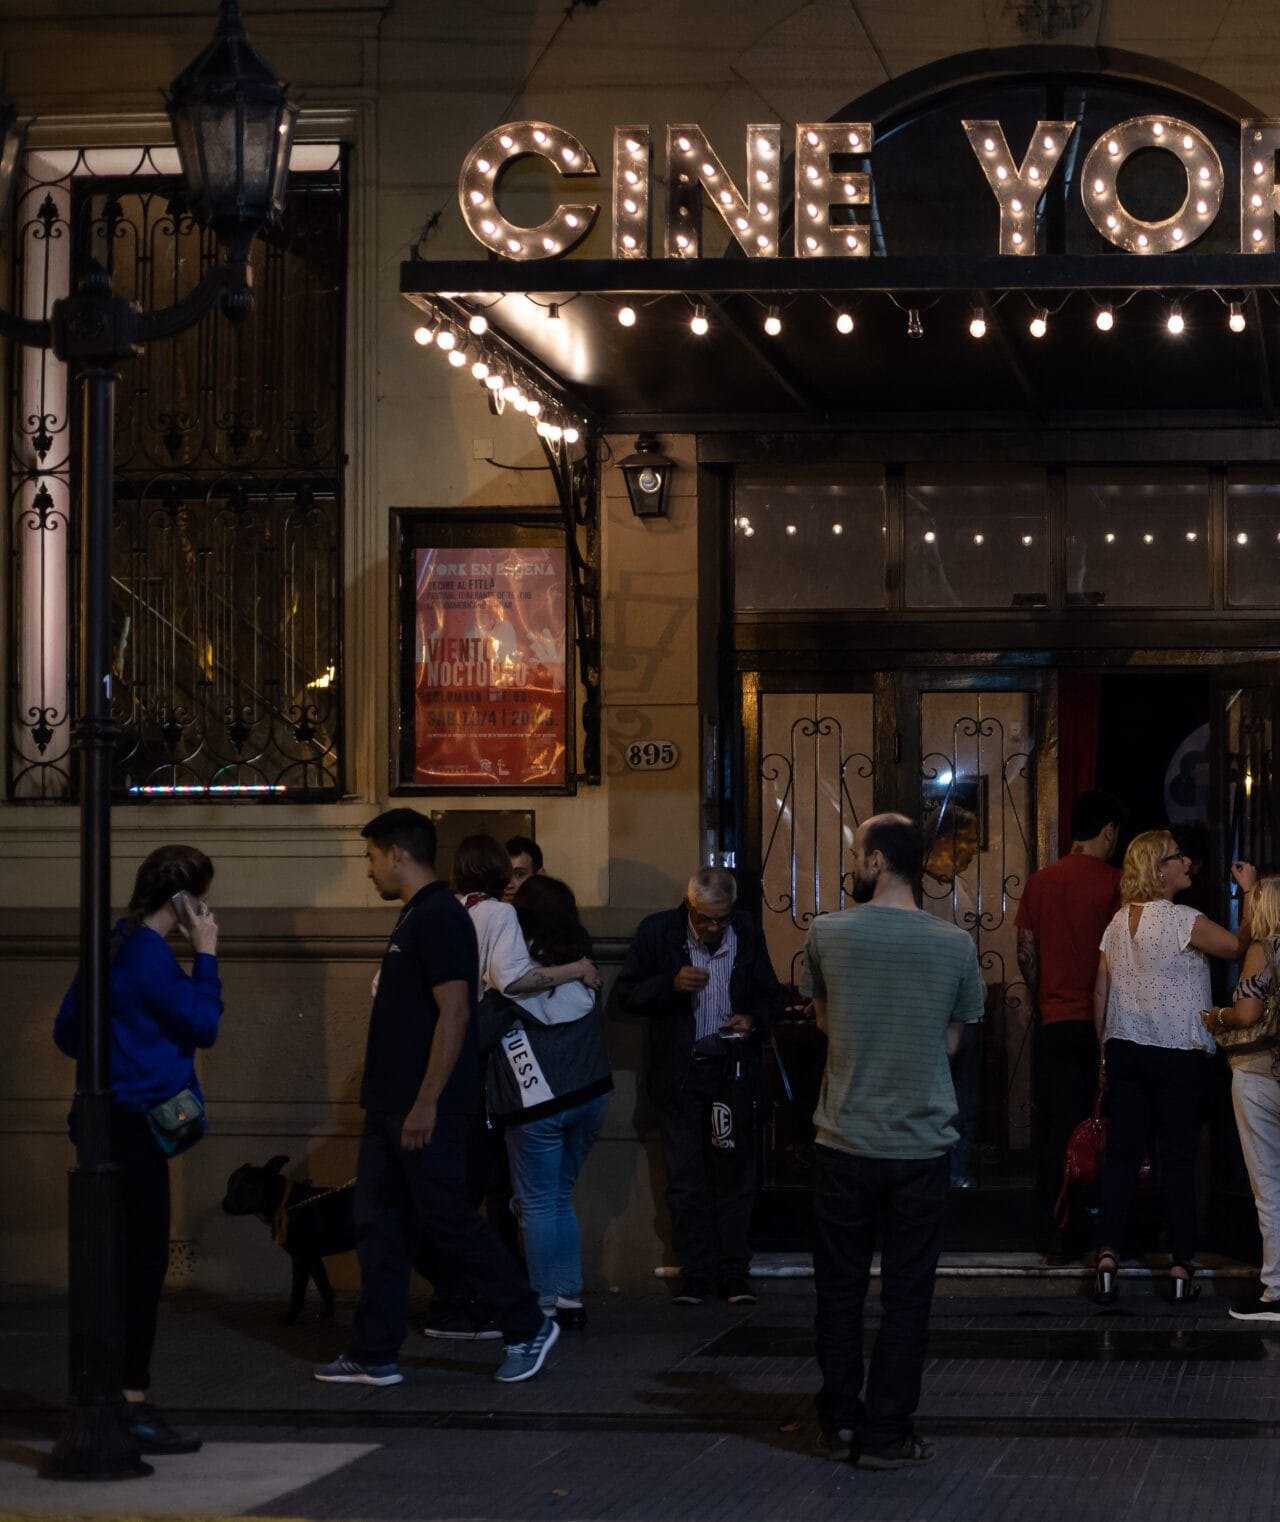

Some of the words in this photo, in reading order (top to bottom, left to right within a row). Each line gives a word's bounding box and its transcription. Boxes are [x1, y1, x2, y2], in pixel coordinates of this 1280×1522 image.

[458, 120, 874, 260] CINE
[471, 563, 492, 576] EN
[629, 743, 674, 766] 895
[503, 1027, 539, 1089] GUESS
